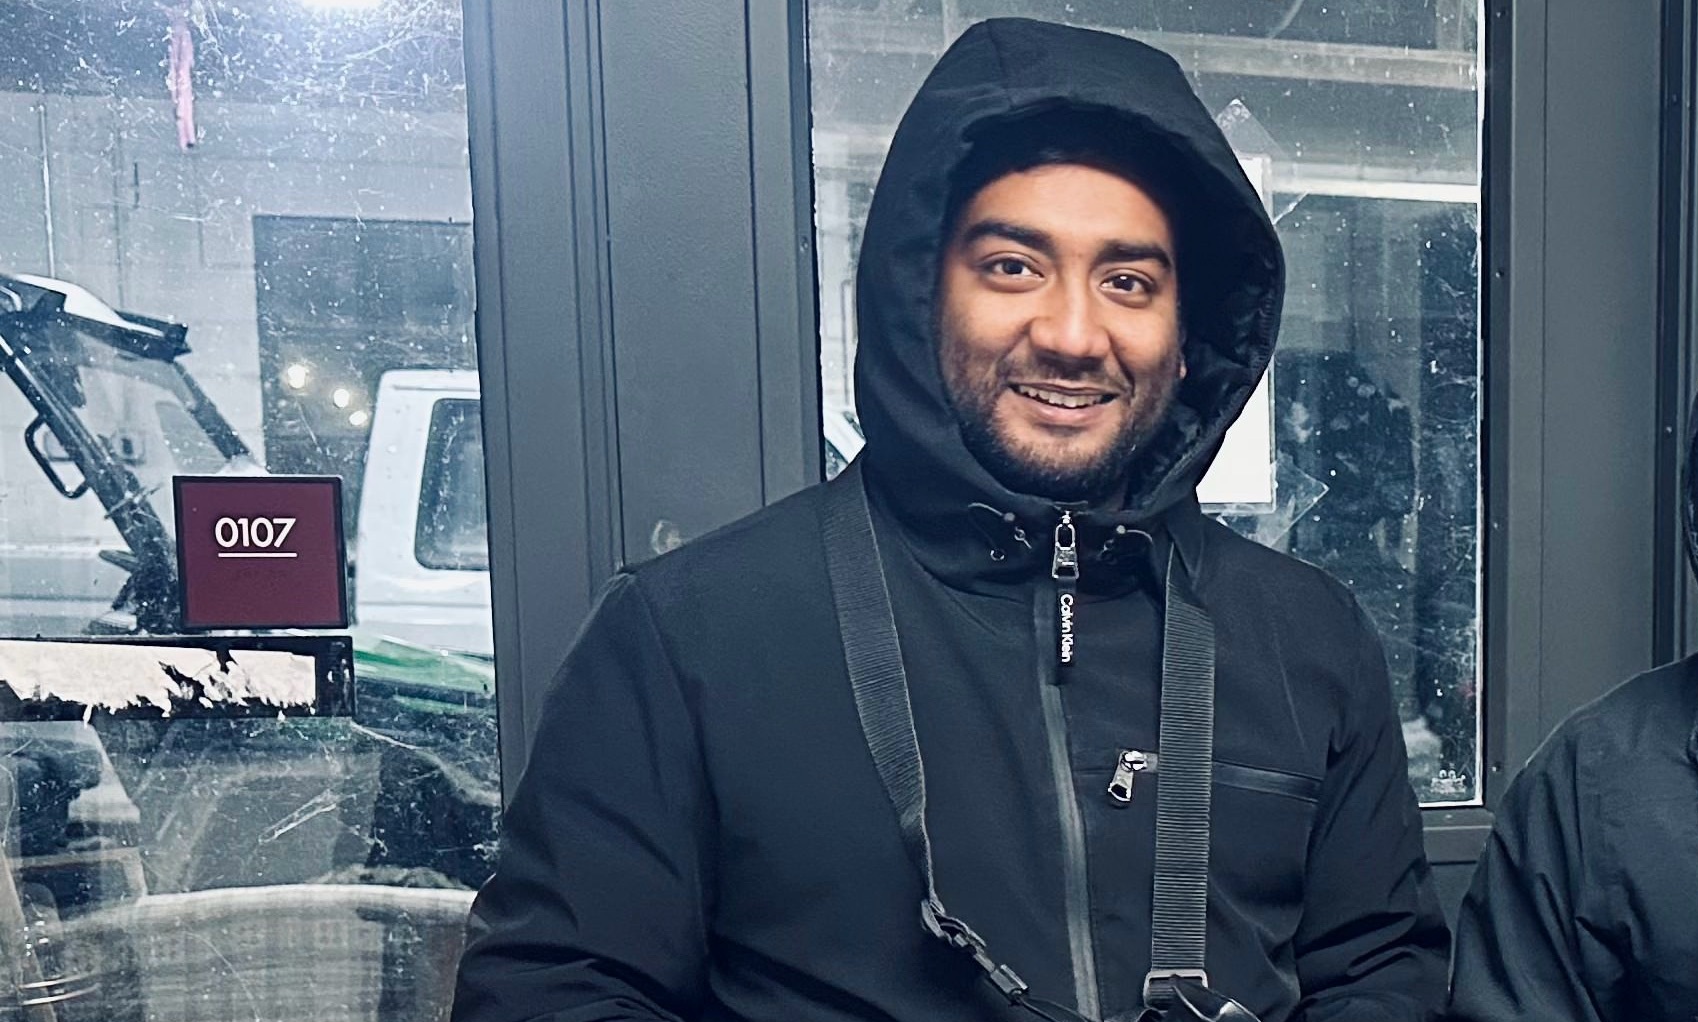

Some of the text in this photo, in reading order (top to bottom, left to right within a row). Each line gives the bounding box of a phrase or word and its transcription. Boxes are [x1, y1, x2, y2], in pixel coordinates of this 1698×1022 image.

[214, 516, 297, 548] 0107
[1060, 593, 1074, 663] Calvin Klein
